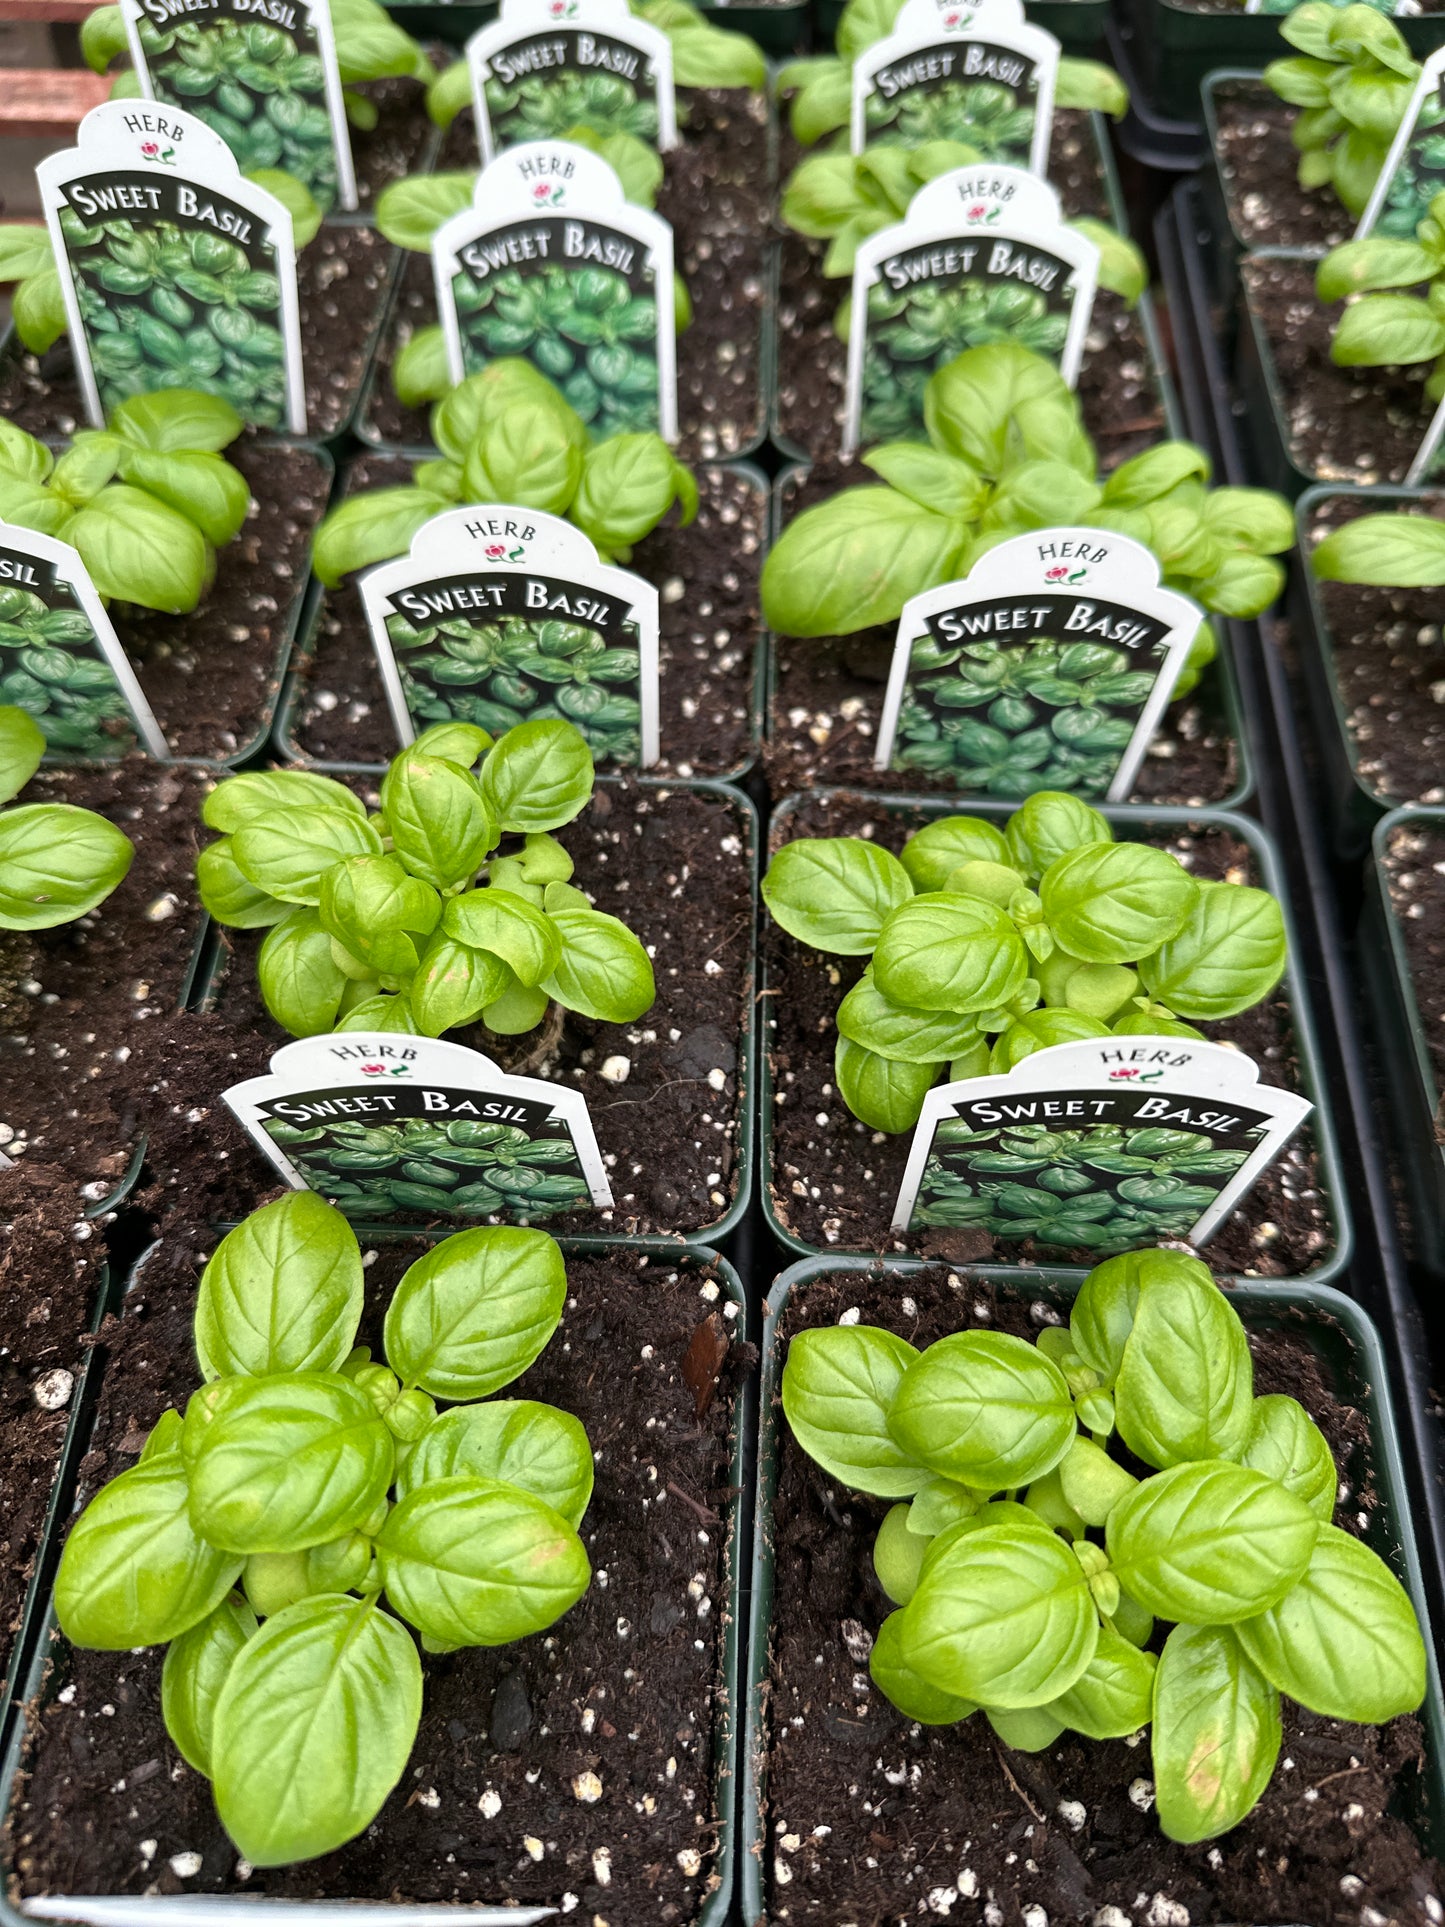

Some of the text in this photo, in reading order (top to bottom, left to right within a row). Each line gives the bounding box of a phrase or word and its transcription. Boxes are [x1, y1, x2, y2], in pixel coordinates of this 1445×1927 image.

[491, 32, 639, 83] SWEET BASIL
[876, 44, 1025, 98] SWEET BASIL
[124, 114, 185, 142] HERB
[518, 153, 577, 180] HERB
[958, 180, 1018, 202] HERB
[69, 184, 252, 245] SWEET BASIL
[462, 220, 635, 279] SWEET BASIL
[884, 241, 1059, 292] SWEET BASIL
[464, 520, 537, 542] HERB
[1037, 541, 1109, 563] HERB
[400, 580, 610, 626] SWEET BASIL
[937, 601, 1153, 649] SWEET BASIL
[329, 1045, 419, 1061] HERB
[1099, 1049, 1193, 1067] HERB
[272, 1091, 529, 1123] SWEET BASIL
[970, 1097, 1243, 1133] SWEET BASIL
